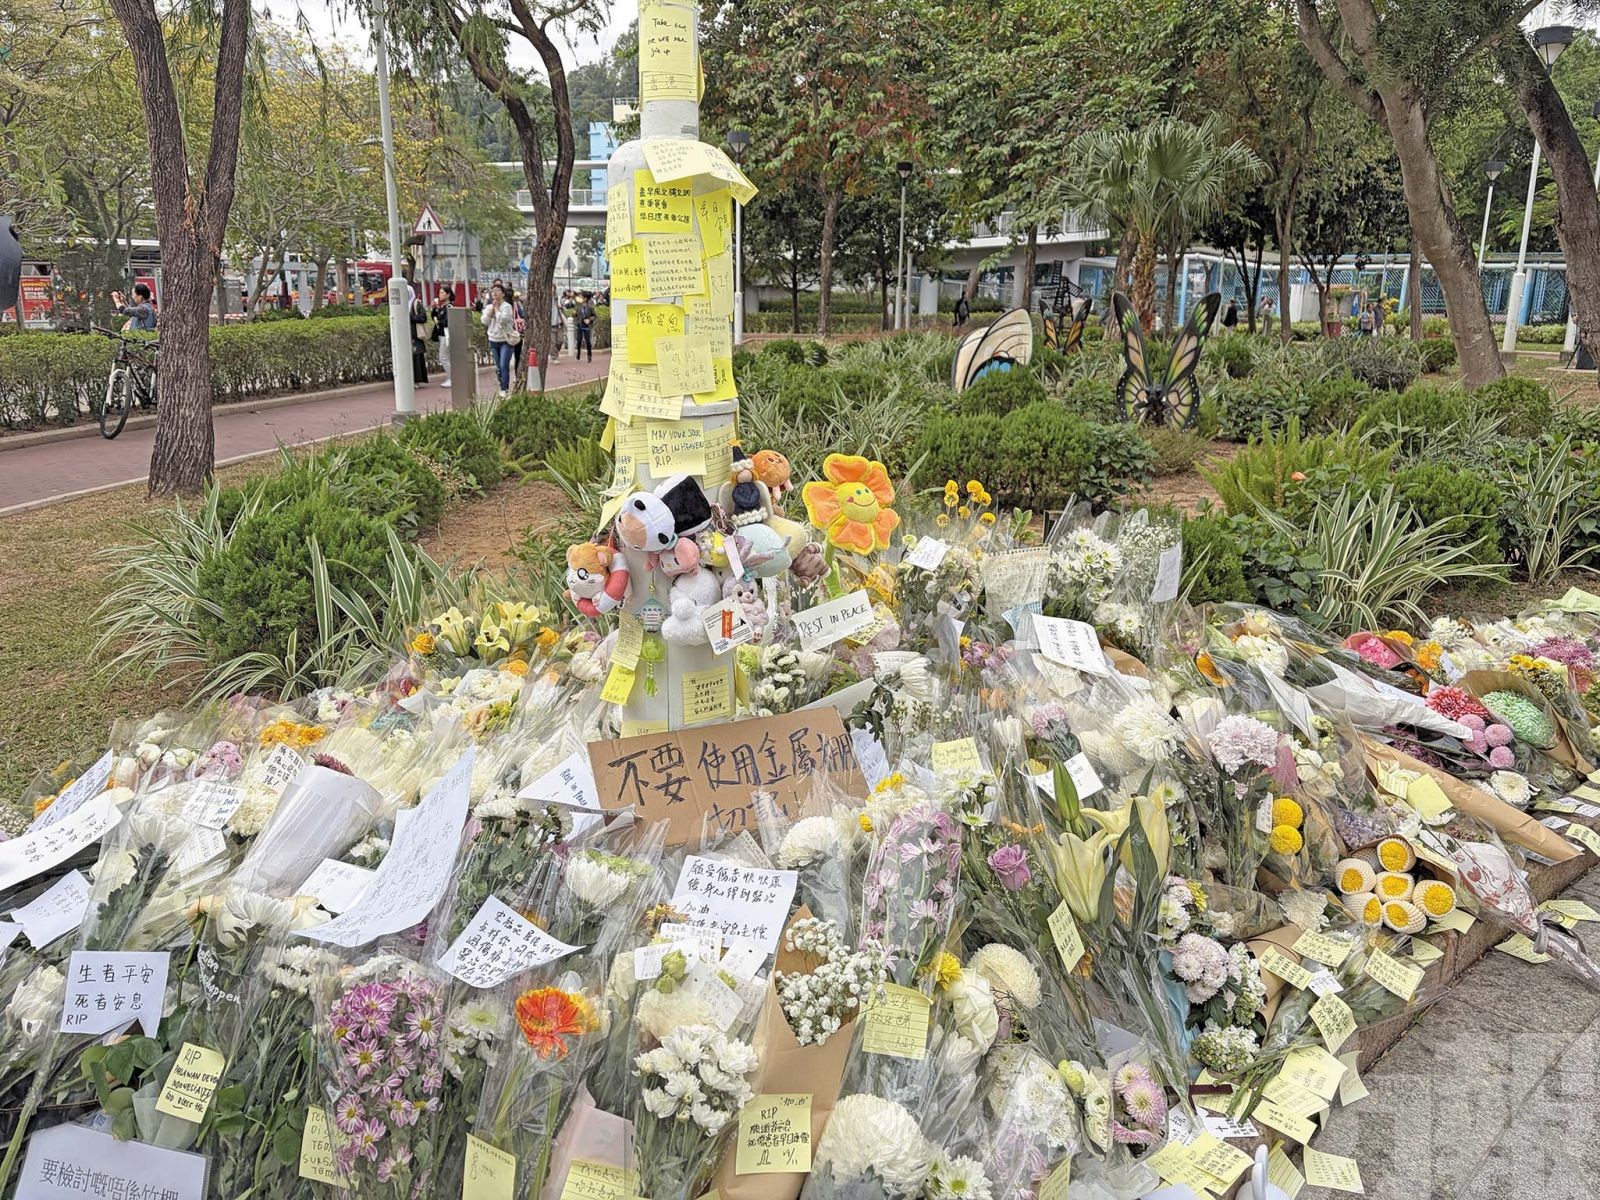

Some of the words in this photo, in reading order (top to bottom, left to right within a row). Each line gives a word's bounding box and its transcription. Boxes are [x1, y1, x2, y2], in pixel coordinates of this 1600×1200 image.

[652, 18, 671, 28] Take
[651, 430, 667, 440] MAY
[669, 430, 686, 439] YOUR
[688, 428, 702, 437] SOUL
[652, 443, 668, 455] REST
[671, 445, 680, 453] IN
[799, 616, 824, 639] REST
[829, 614, 839, 624] IN
[841, 604, 868, 621] PEACE
[607, 727, 859, 806] 不要使用金屬棚
[560, 768, 574, 785] Rest
[571, 782, 578, 793] in
[573, 789, 588, 807] Peace
[77, 963, 155, 985] 生者平安
[74, 992, 145, 1011] 死者安息
[66, 1013, 88, 1026] RIP
[183, 1048, 202, 1066] RIP
[760, 1106, 778, 1120] RIP
